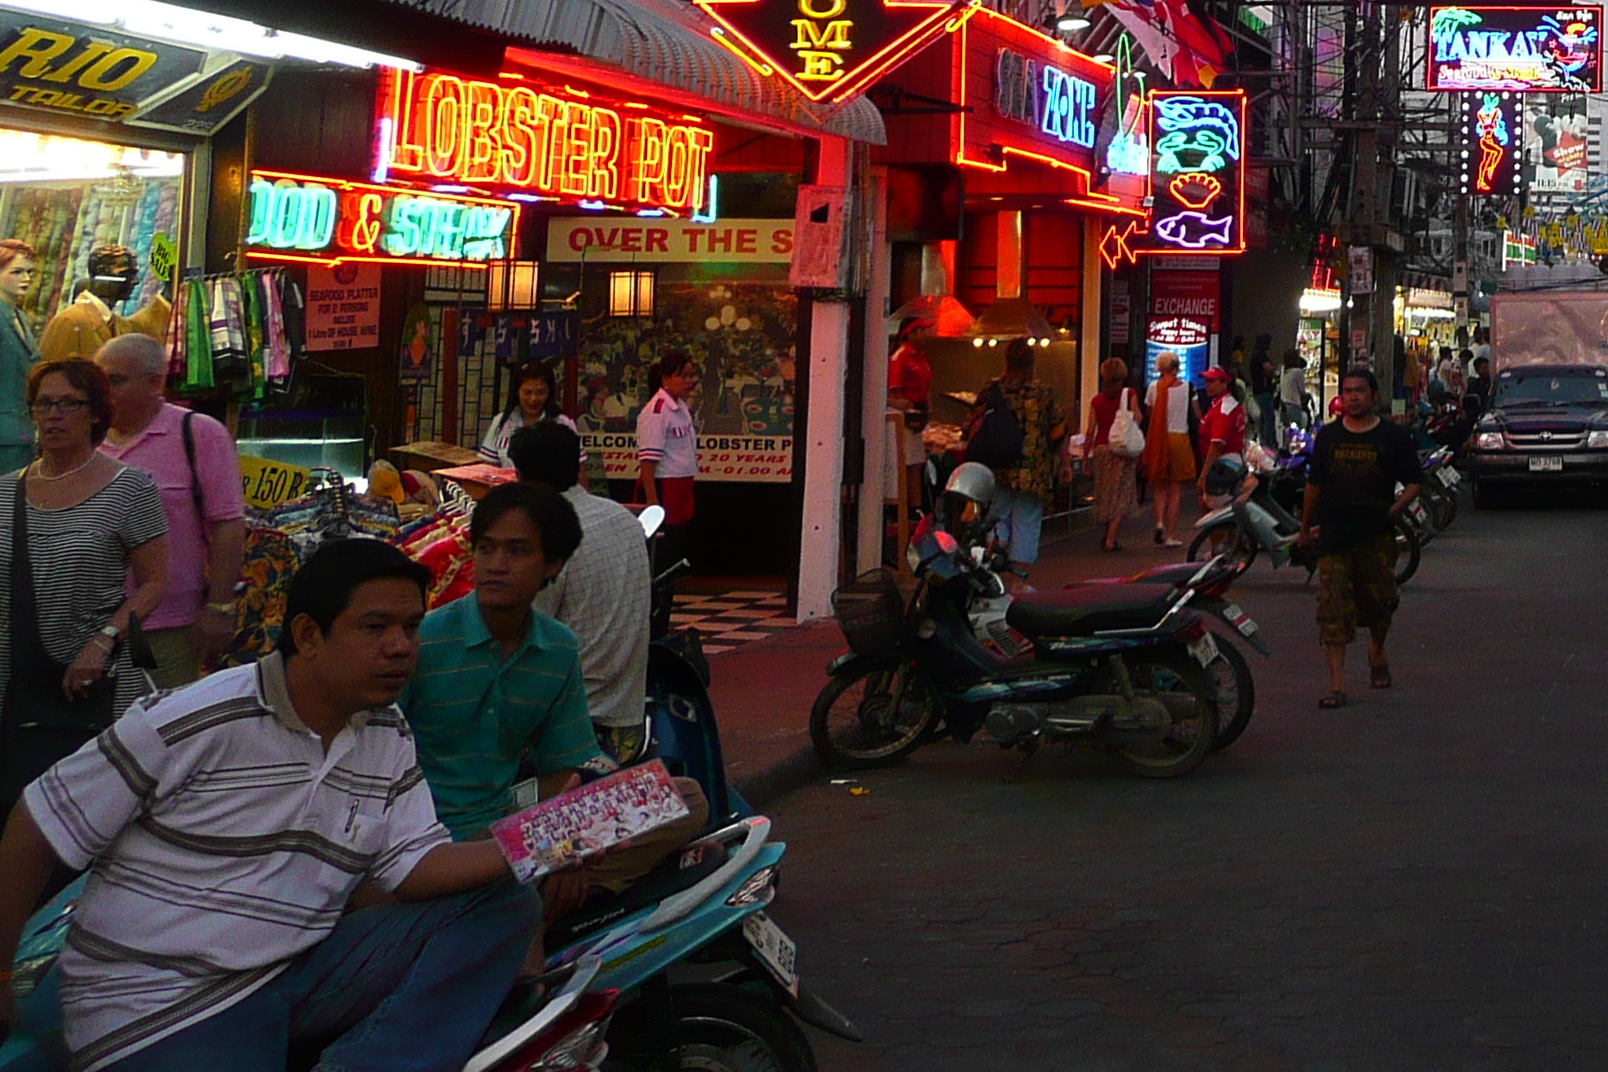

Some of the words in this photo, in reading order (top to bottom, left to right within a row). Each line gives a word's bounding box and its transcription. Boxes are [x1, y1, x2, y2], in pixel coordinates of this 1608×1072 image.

[10, 85, 138, 118] TAILOR
[388, 66, 621, 200] LOBSTER
[637, 116, 714, 212] POT
[346, 193, 383, 254] &
[386, 193, 512, 260] STEAK
[568, 227, 670, 253] OVER
[682, 227, 757, 253] THE
[310, 289, 344, 302] SEAFOOD
[347, 287, 378, 300] PLATTER
[1154, 298, 1216, 316] EXCHANGE
[696, 438, 777, 452] LOBSTER
[736, 454, 788, 464] YEARS
[251, 467, 287, 504] 150
